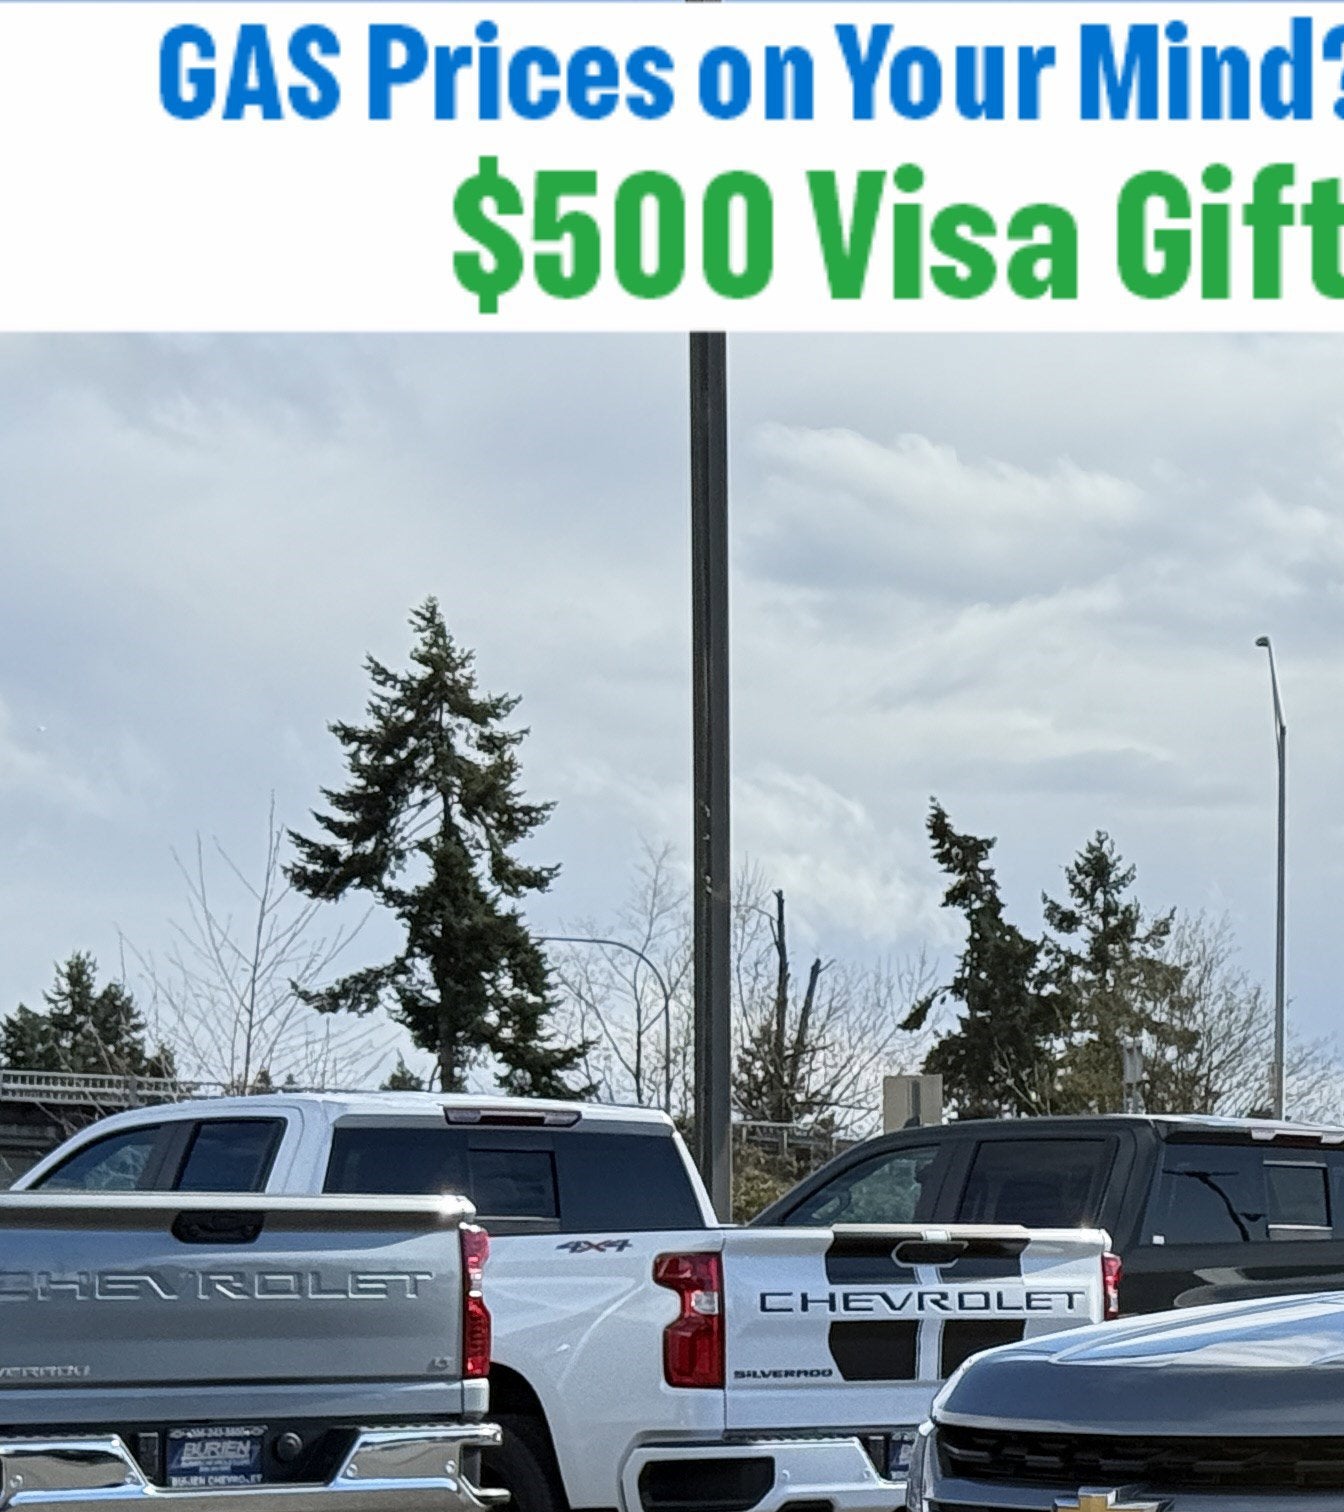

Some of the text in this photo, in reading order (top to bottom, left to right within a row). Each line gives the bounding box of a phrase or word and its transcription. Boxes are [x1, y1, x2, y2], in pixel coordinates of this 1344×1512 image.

[759, 1290, 1087, 1314] CHEVROLET
[733, 1368, 834, 1379] SILVERADO
[183, 1440, 251, 1458] BURIEN
